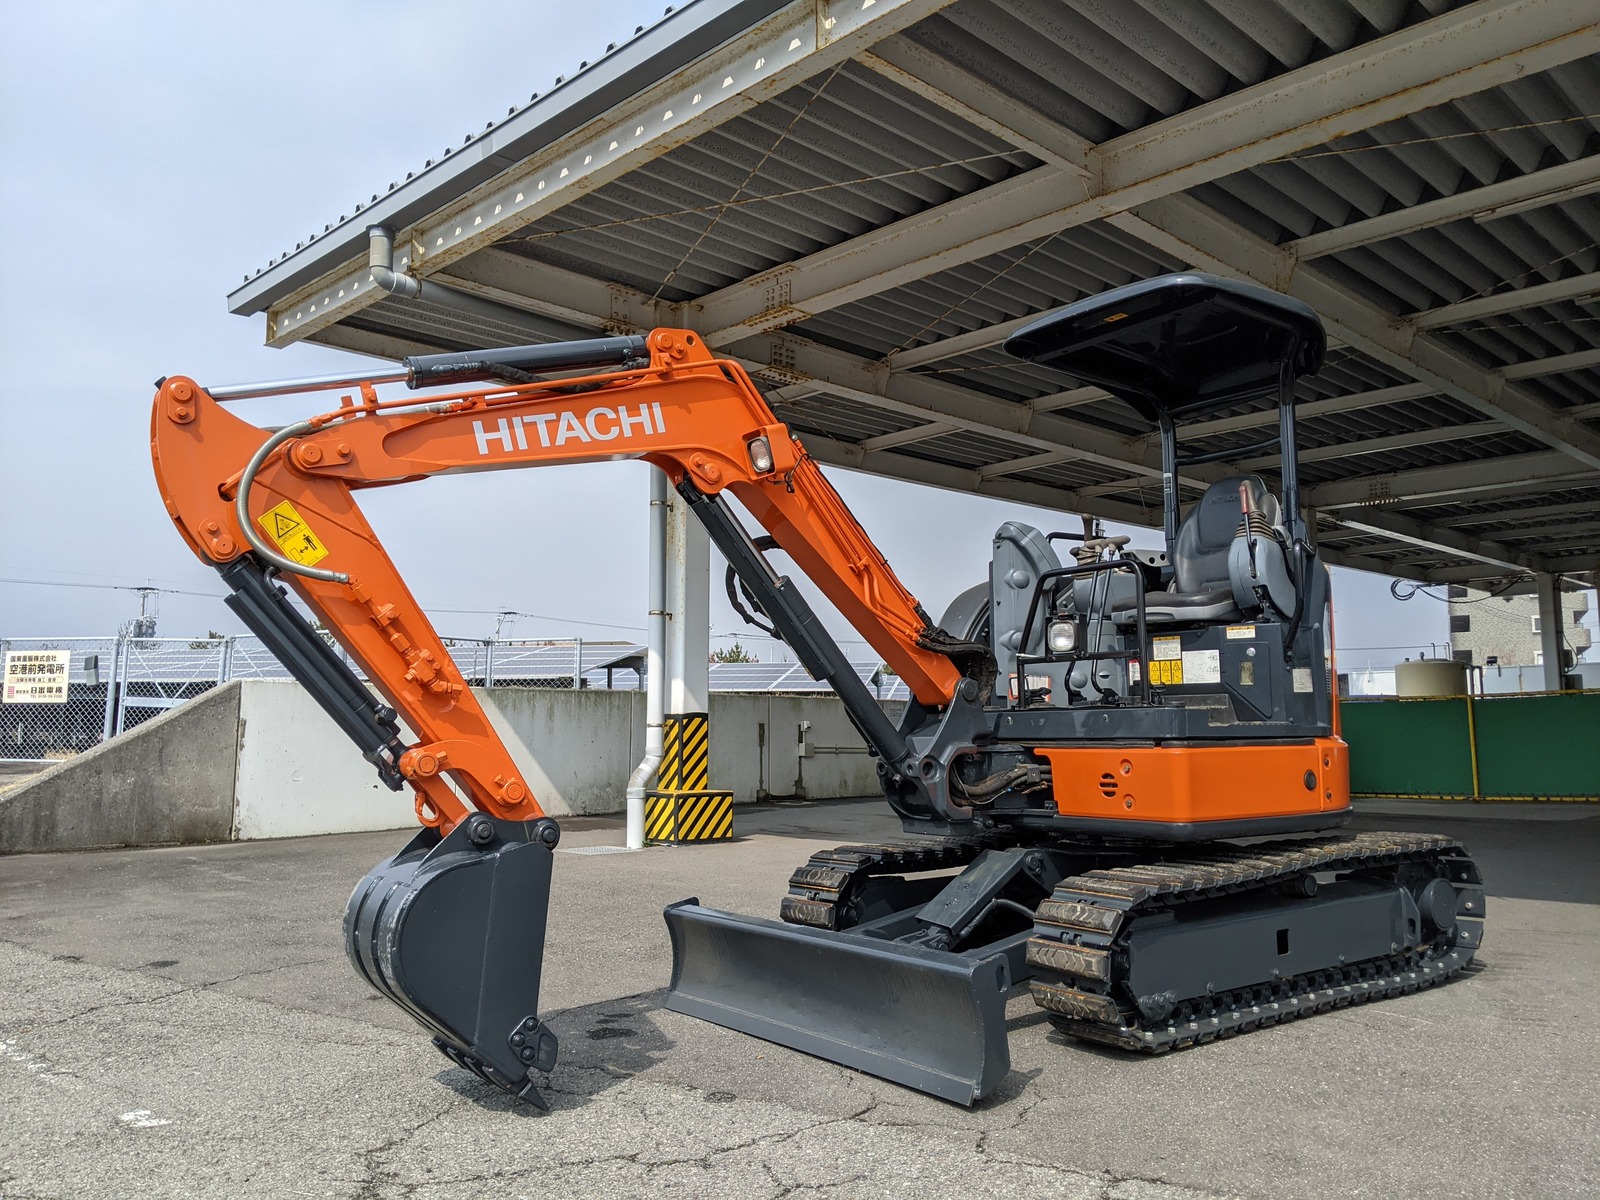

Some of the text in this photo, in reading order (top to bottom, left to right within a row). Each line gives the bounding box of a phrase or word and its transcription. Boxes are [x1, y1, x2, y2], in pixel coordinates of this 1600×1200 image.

[472, 402, 666, 455] HITACHI
[9, 664, 64, 674] 空港前発電所
